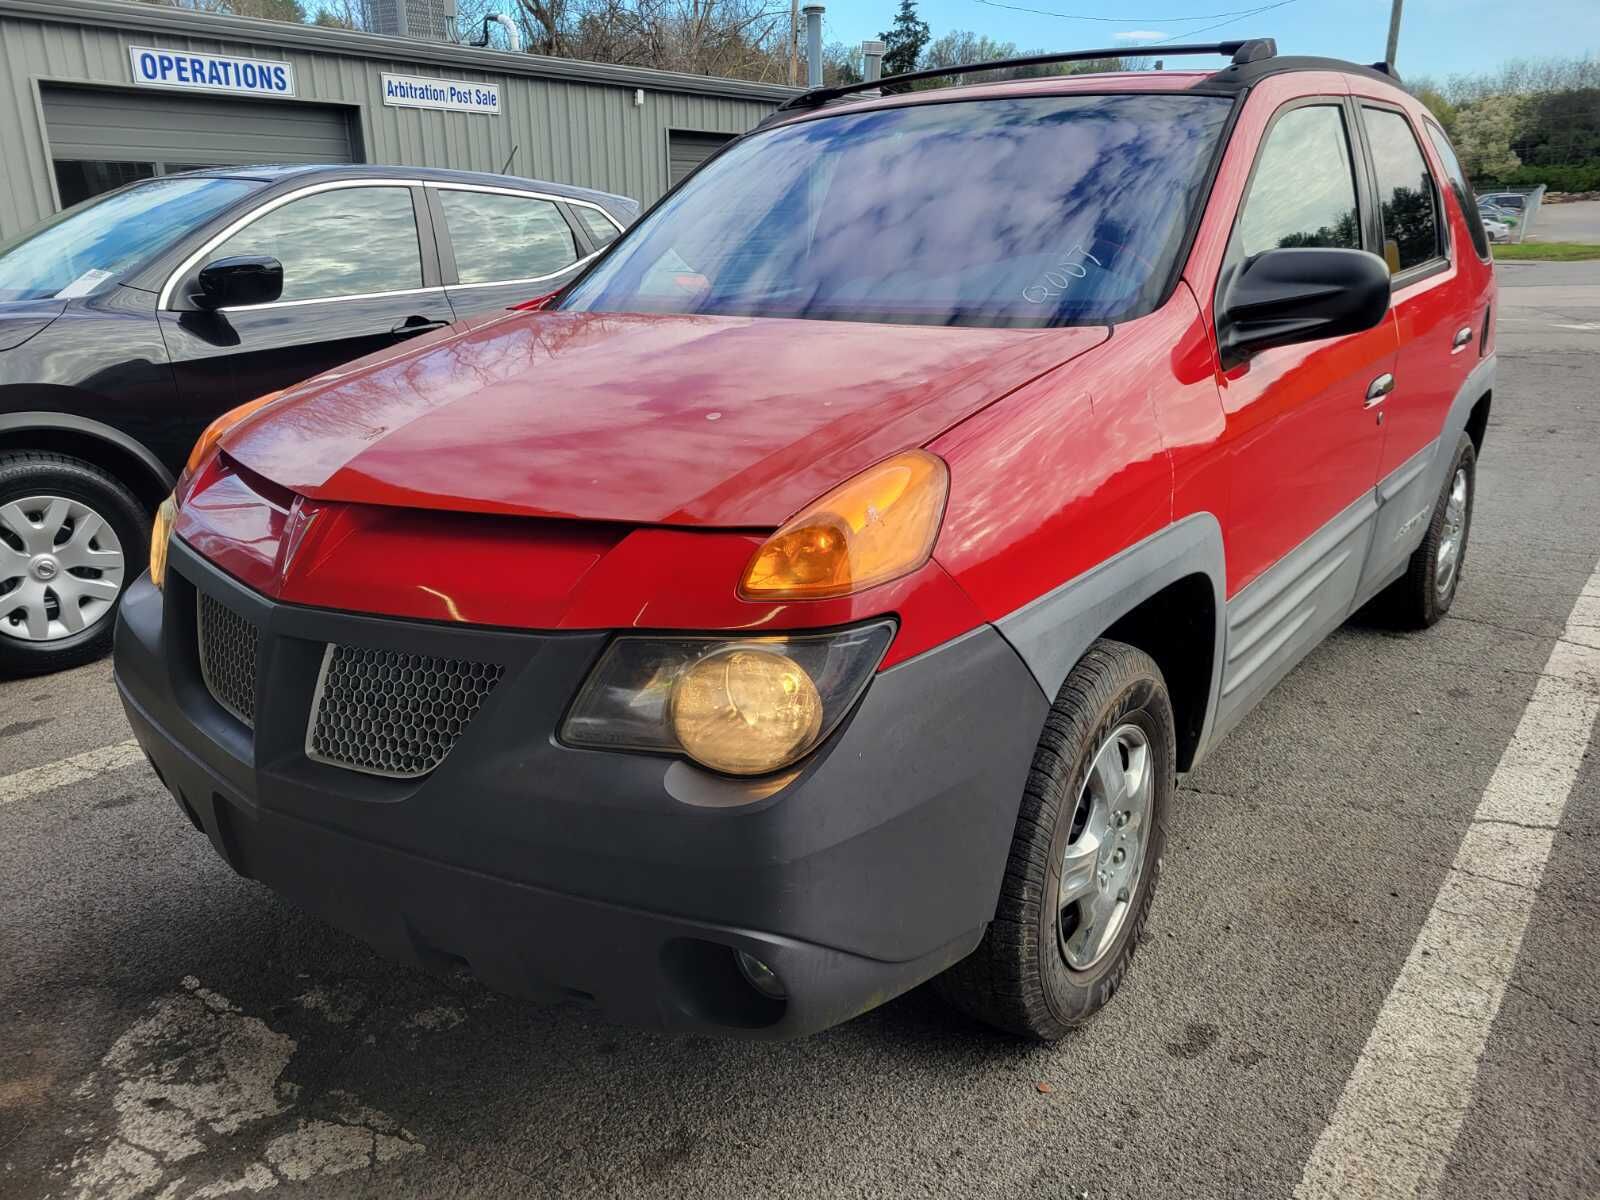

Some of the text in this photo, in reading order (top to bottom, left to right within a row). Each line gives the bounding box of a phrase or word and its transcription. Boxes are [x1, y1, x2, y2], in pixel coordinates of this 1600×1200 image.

[140, 52, 287, 91] OPERATIONS
[386, 79, 497, 107] Arbitration/Post Sale
